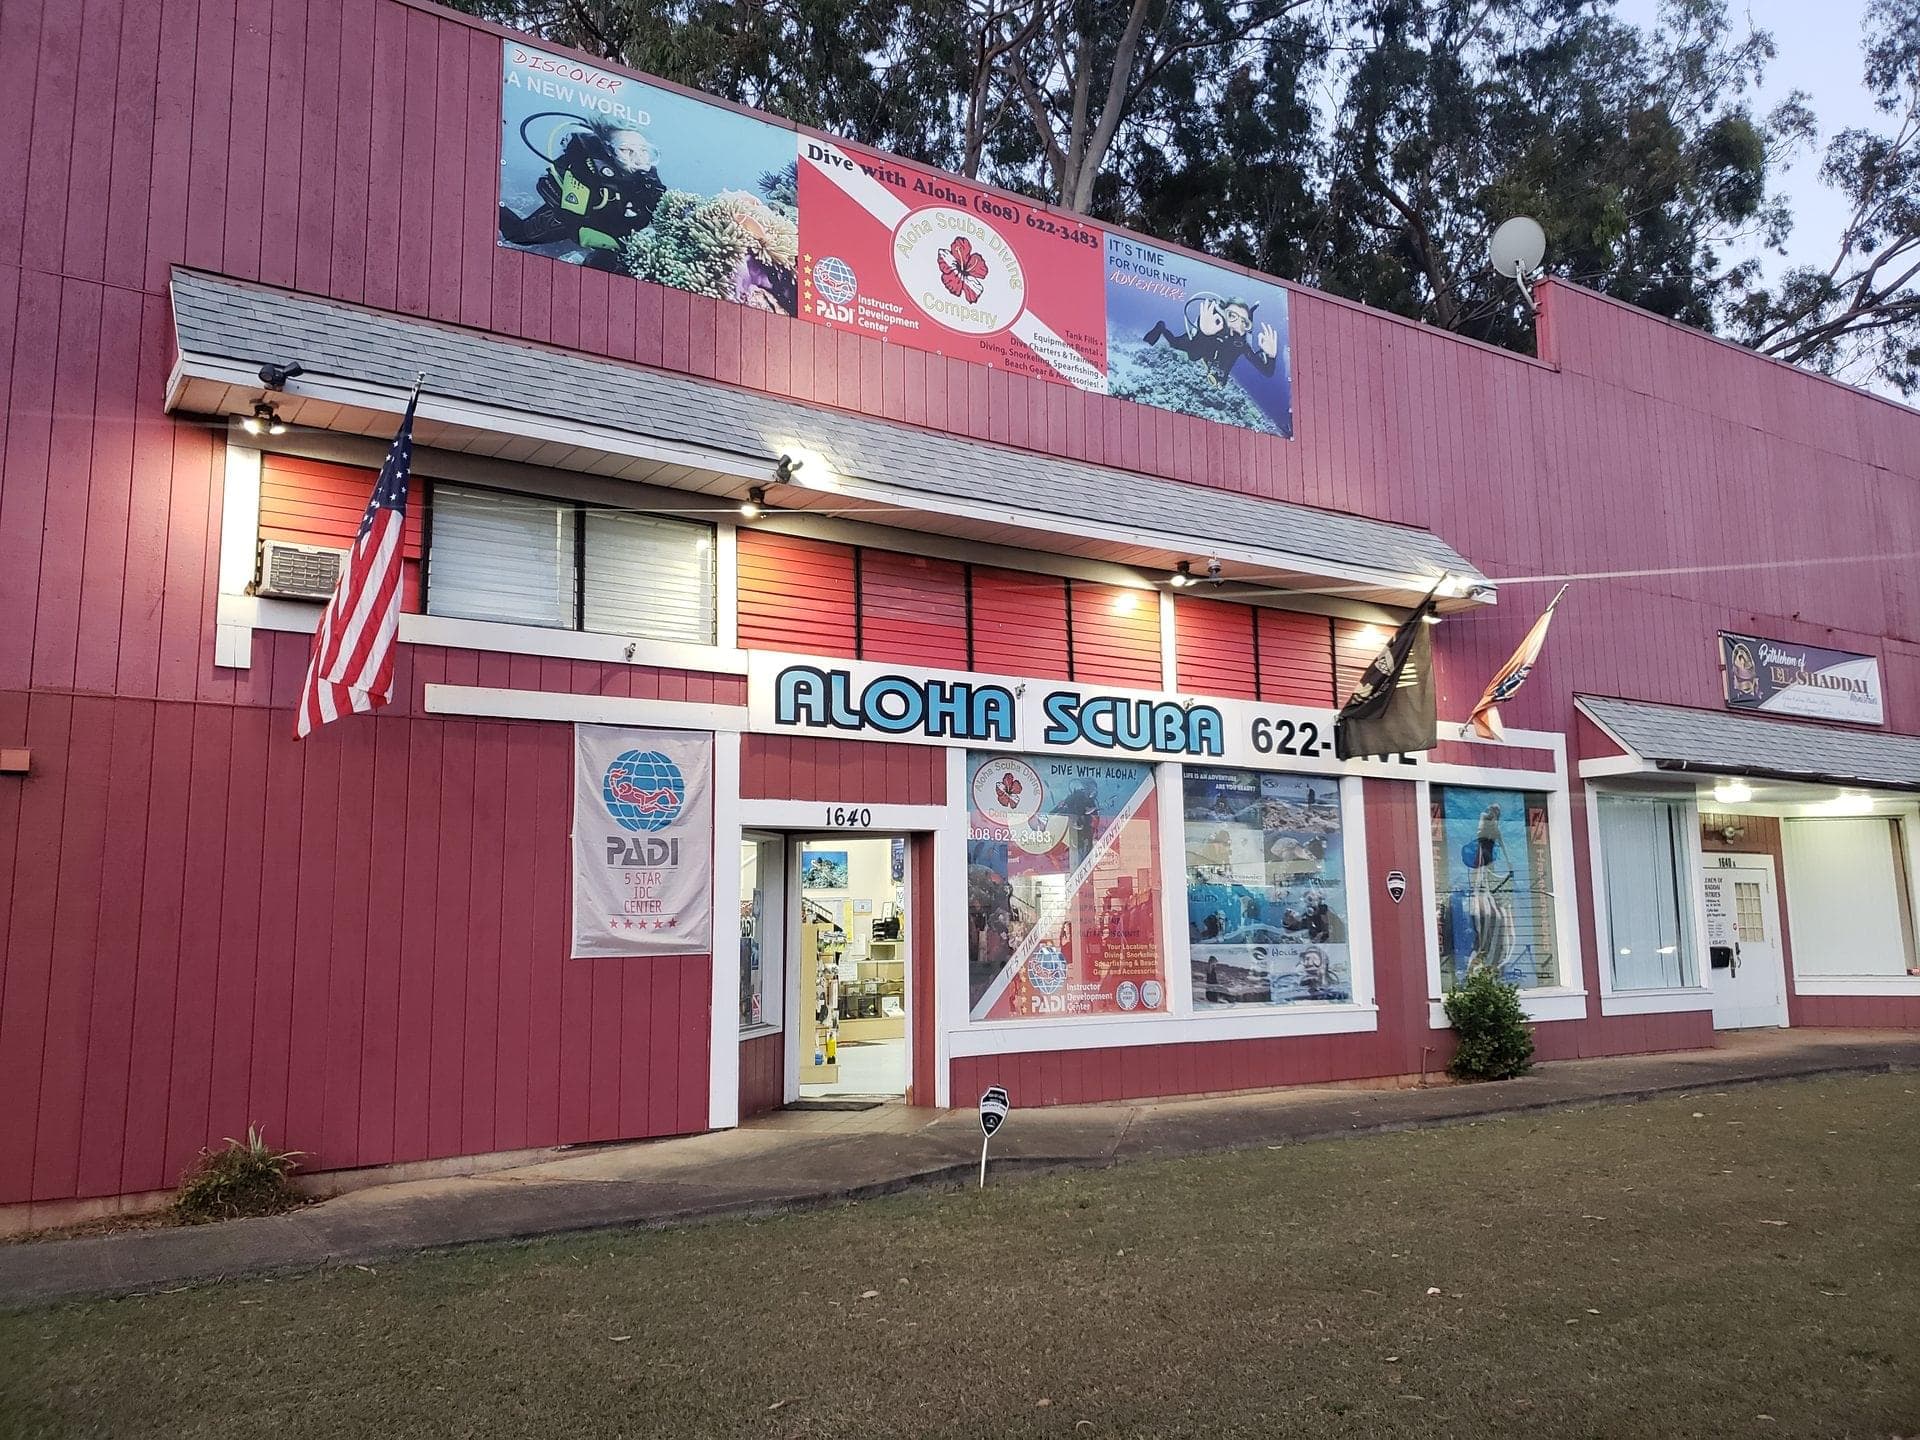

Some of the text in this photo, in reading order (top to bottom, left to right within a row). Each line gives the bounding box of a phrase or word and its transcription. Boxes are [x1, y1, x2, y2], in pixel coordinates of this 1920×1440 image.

[512, 49, 625, 95] DISCOVER
[507, 70, 651, 126] A NEW WORLD
[807, 143, 1098, 249] Dive with Aloha (808) 622-3483
[896, 211, 1022, 290] Aloha Scuba Diving
[1109, 238, 1165, 267] IT'S TIME
[1109, 256, 1188, 288] FOR YOUR NEXT
[816, 299, 855, 324] PADI
[858, 294, 903, 313] Instructor
[922, 291, 998, 329] Company
[858, 305, 920, 329] Development
[858, 318, 889, 333] Center
[1033, 333, 1074, 350] Equipment
[1065, 330, 1098, 346] Tank Fills
[980, 340, 1099, 379] Diving, Snorkeling, Spearfishing
[1010, 337, 1099, 368] Dive Charters & Training
[1005, 358, 1028, 371] Beach
[1029, 365, 1047, 376] Gear
[1048, 368, 1054, 377] &
[1796, 671, 1869, 694] SHADDAI
[775, 664, 1018, 743] ALOHA
[1043, 691, 1225, 757] SCUBA
[974, 760, 1042, 796] Aloha Scuba Diving
[1051, 765, 1137, 780] DIVE WITH ALOHA!
[825, 807, 871, 827] 1640
[606, 836, 679, 866] PADI
[624, 872, 661, 885] 5 STAR
[1075, 860, 1092, 886] NEXT
[634, 887, 652, 899] IDC
[624, 900, 662, 913] CENTER
[1005, 955, 1019, 980] IT'S
[1021, 932, 1040, 957] TIME
[1067, 983, 1101, 991] Instructor
[1067, 992, 1113, 1001] Development
[1031, 995, 1065, 1013] PADI
[1067, 1003, 1090, 1013] Center
